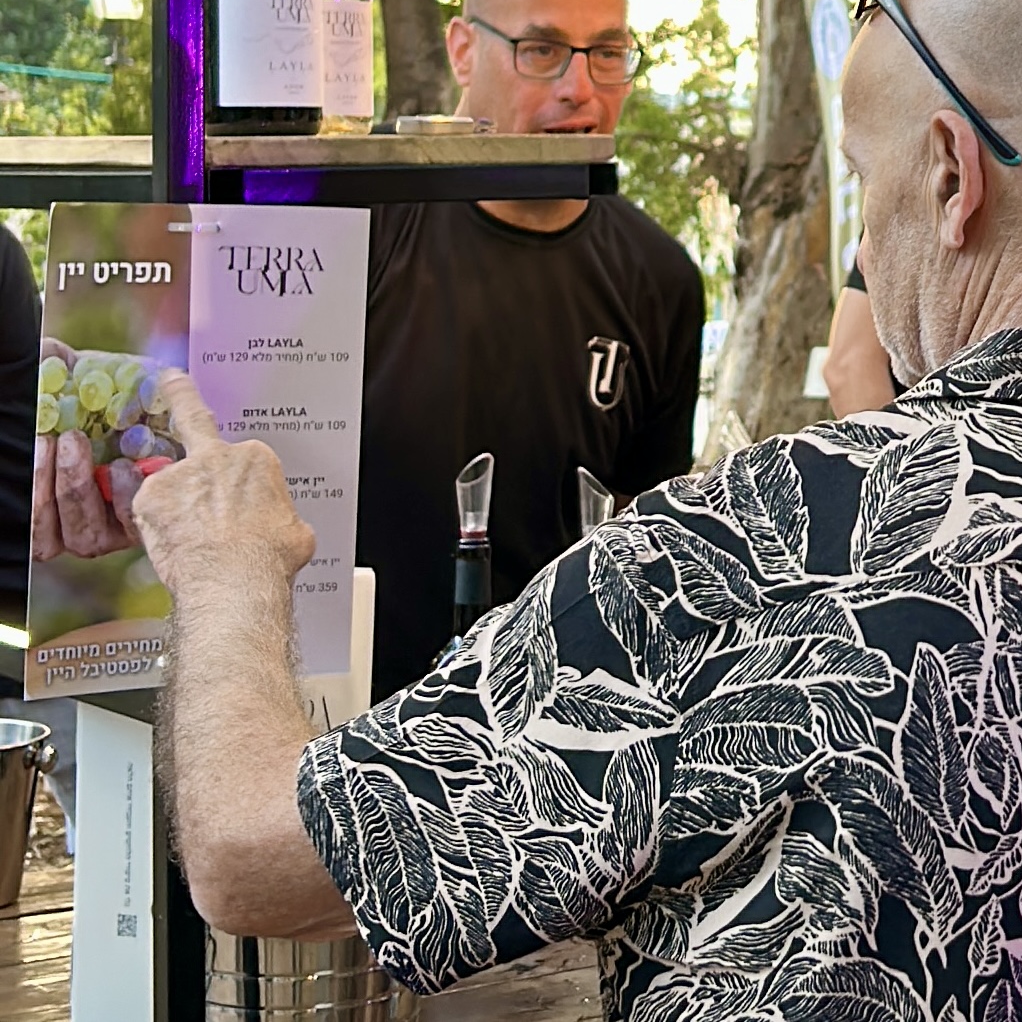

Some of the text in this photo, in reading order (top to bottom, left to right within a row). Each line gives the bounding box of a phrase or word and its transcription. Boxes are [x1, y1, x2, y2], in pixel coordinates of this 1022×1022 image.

[218, 245, 325, 272] TERRA
[58, 261, 171, 291] תפריט יין
[237, 269, 314, 297] UMA
[248, 337, 304, 349] LAYLA לבן
[229, 352, 249, 362] 129
[251, 351, 273, 362] מלא
[330, 352, 350, 362] 109
[242, 407, 308, 418] LAYLA אדום
[227, 421, 247, 432] 129
[249, 421, 271, 431] מלא
[327, 420, 347, 430] 109
[313, 477, 325, 487] יין
[325, 488, 344, 498] 149
[318, 582, 338, 593] 359
[37, 638, 163, 664] מחירים מיוחדים
[46, 656, 152, 686] לפסטיבל היין
